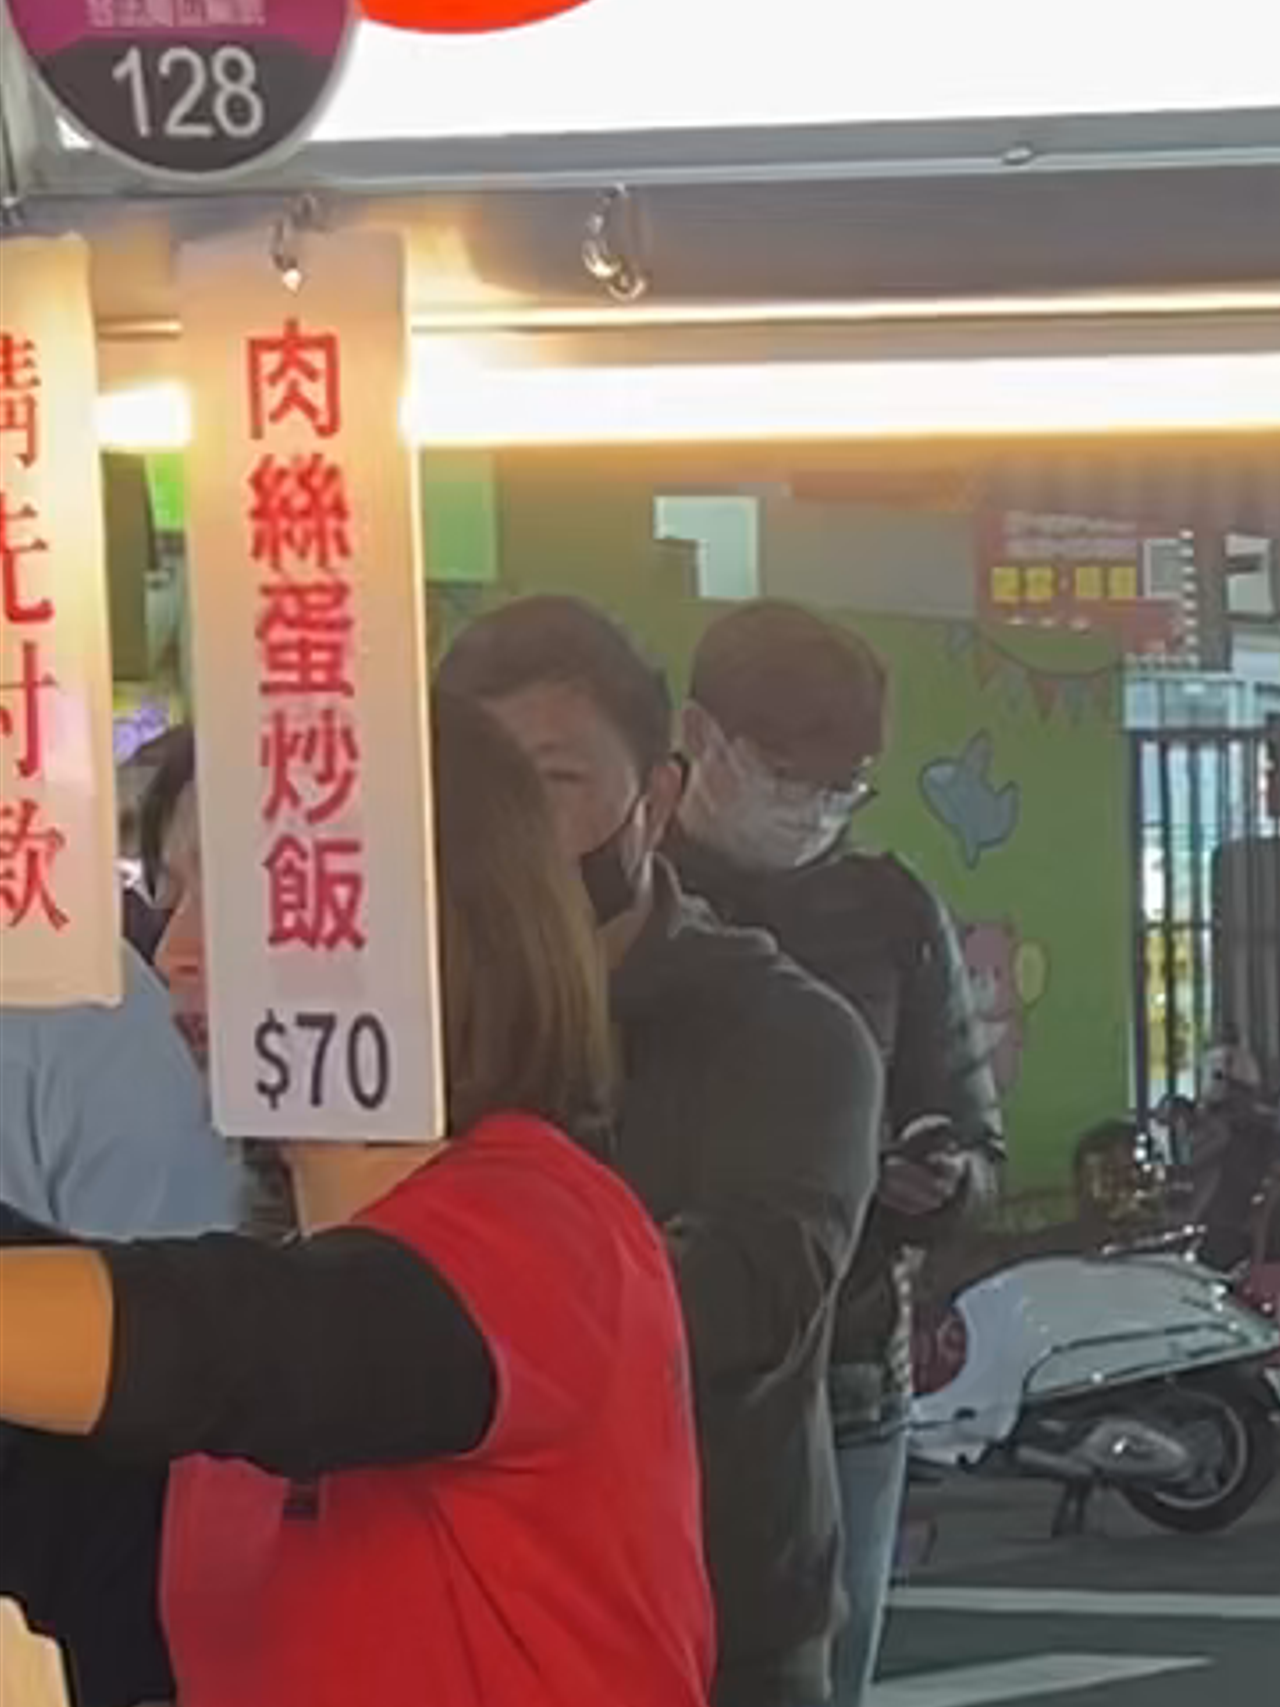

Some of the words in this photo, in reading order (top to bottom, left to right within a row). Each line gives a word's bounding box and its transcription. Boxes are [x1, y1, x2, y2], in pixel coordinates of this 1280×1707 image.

[112, 45, 264, 138] 128
[246, 318, 366, 952] 肉絲蛋炒飯
[255, 1007, 391, 1111] $70
